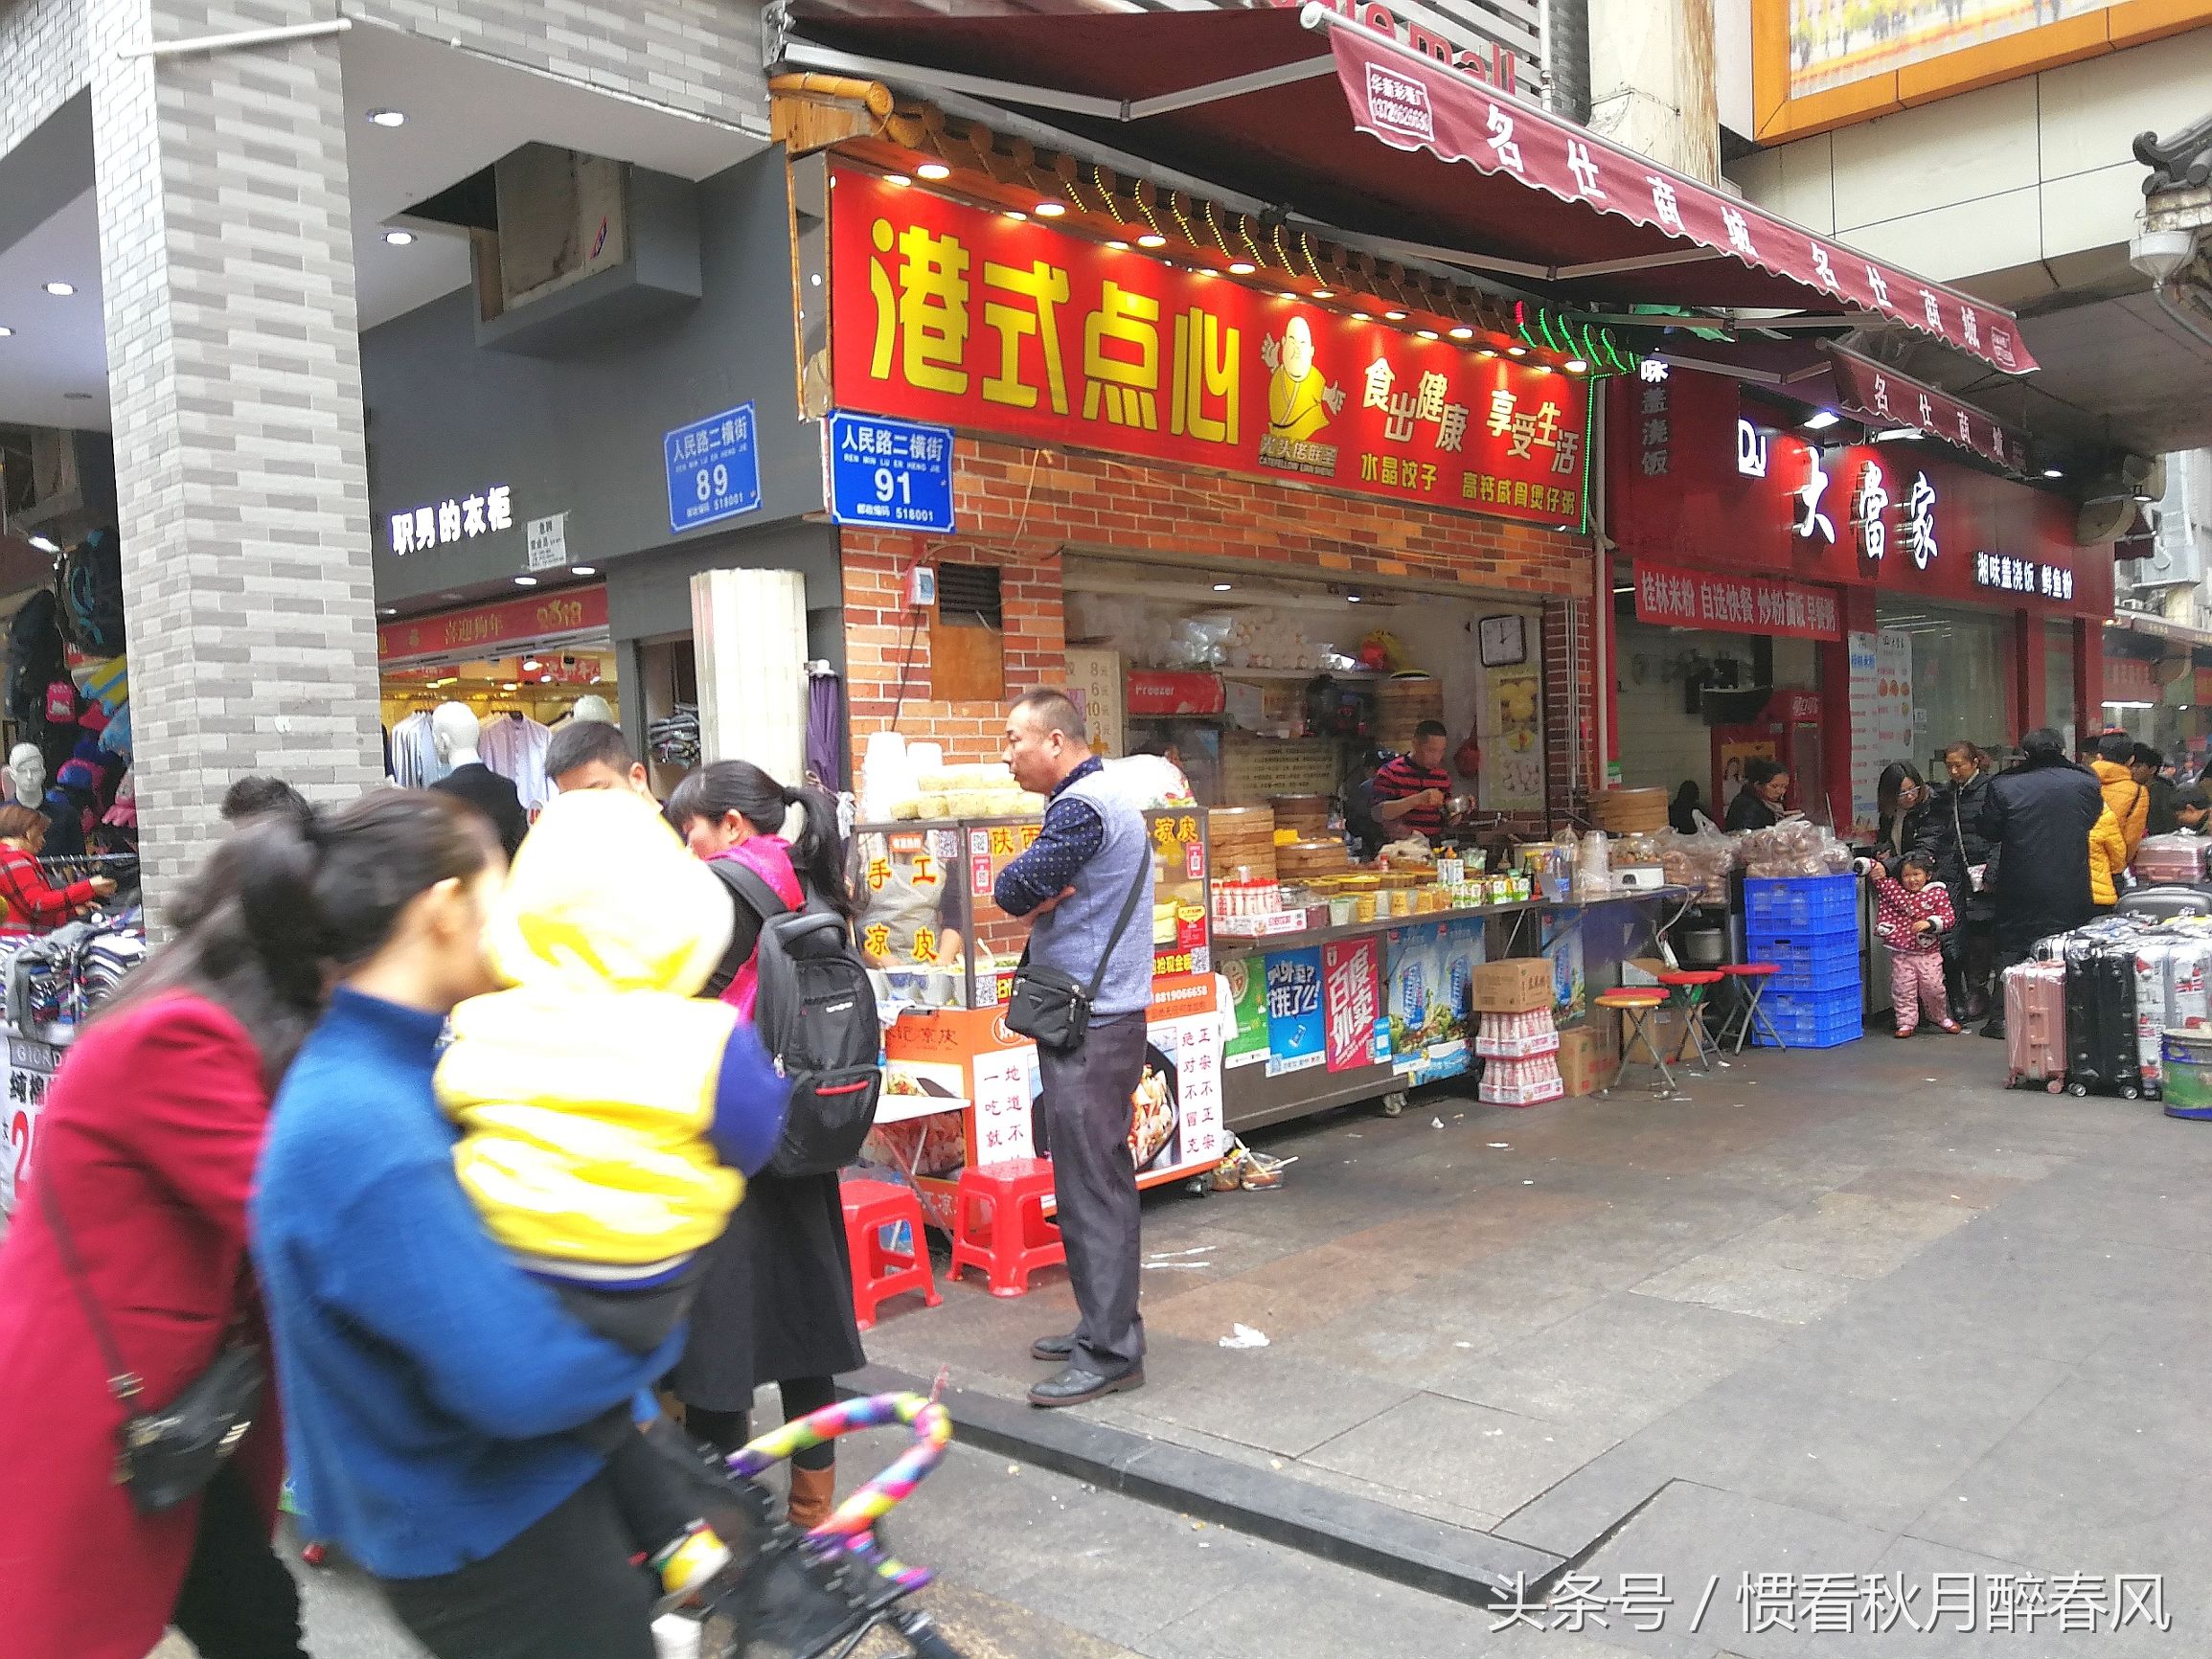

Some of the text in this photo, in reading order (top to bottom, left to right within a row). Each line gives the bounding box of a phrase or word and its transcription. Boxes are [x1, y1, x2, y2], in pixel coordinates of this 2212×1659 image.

[1486, 102, 1981, 349] 名仕商城 名仕商城
[869, 216, 1241, 445] 港式点心
[1363, 357, 1580, 475] 食出健康 享受生活
[841, 423, 945, 463] 人民路二横街
[696, 464, 728, 502] 89
[874, 467, 911, 505] 91
[1360, 452, 1438, 492] 水晶饺子
[391, 486, 513, 556] 职男的衣柜
[895, 507, 934, 522] 518001
[1700, 580, 1754, 624] 自选快餐
[868, 857, 937, 891] 手工
[865, 922, 938, 961] 凉皮
[983, 1074, 1003, 1162] 一吃就
[1005, 1066, 1024, 1162] 地道不
